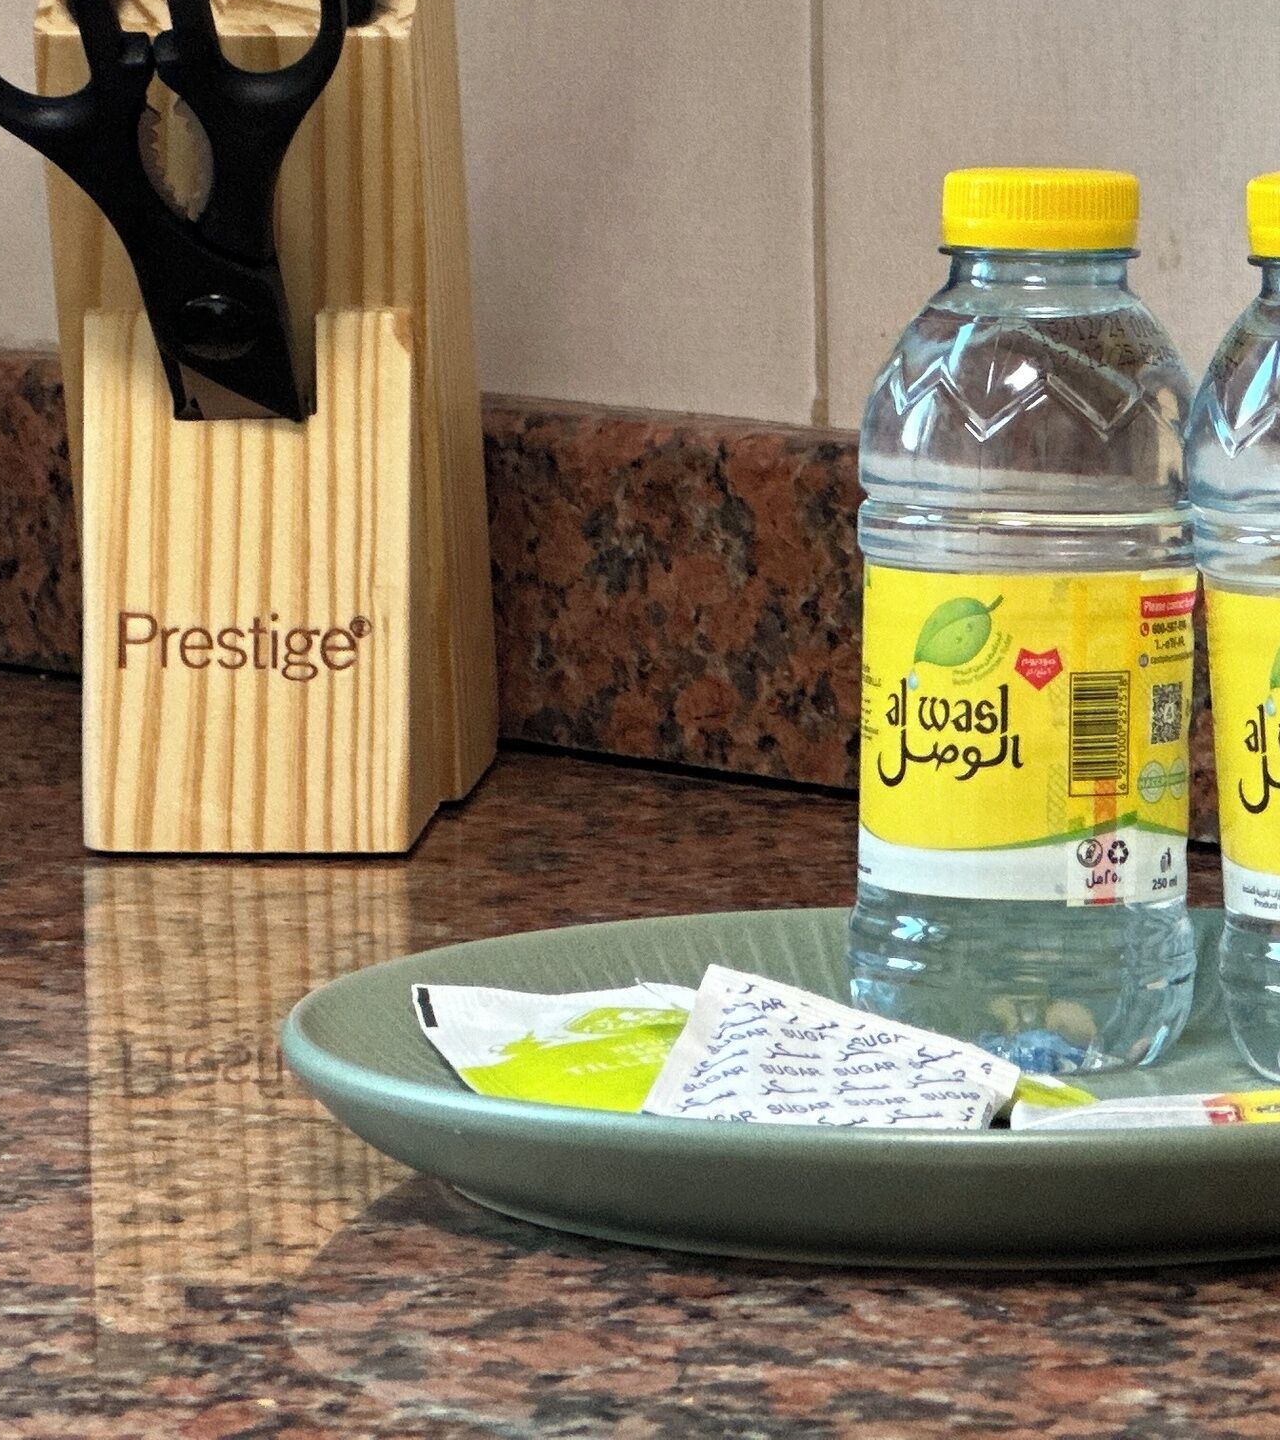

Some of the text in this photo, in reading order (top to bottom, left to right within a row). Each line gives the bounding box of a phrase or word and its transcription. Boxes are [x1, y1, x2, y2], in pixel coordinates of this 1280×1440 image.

[885, 677, 907, 727] al
[919, 684, 1010, 735] wasl
[1244, 703, 1266, 753] al
[877, 728, 1025, 787] الوصل
[1151, 877, 1167, 891] 250
[1253, 898, 1277, 910] Product
[759, 1063, 824, 1076] SUGAR
[833, 1060, 902, 1077] SUGAR
[766, 1101, 835, 1115] SUGAR
[844, 1095, 912, 1107] SUGAR
